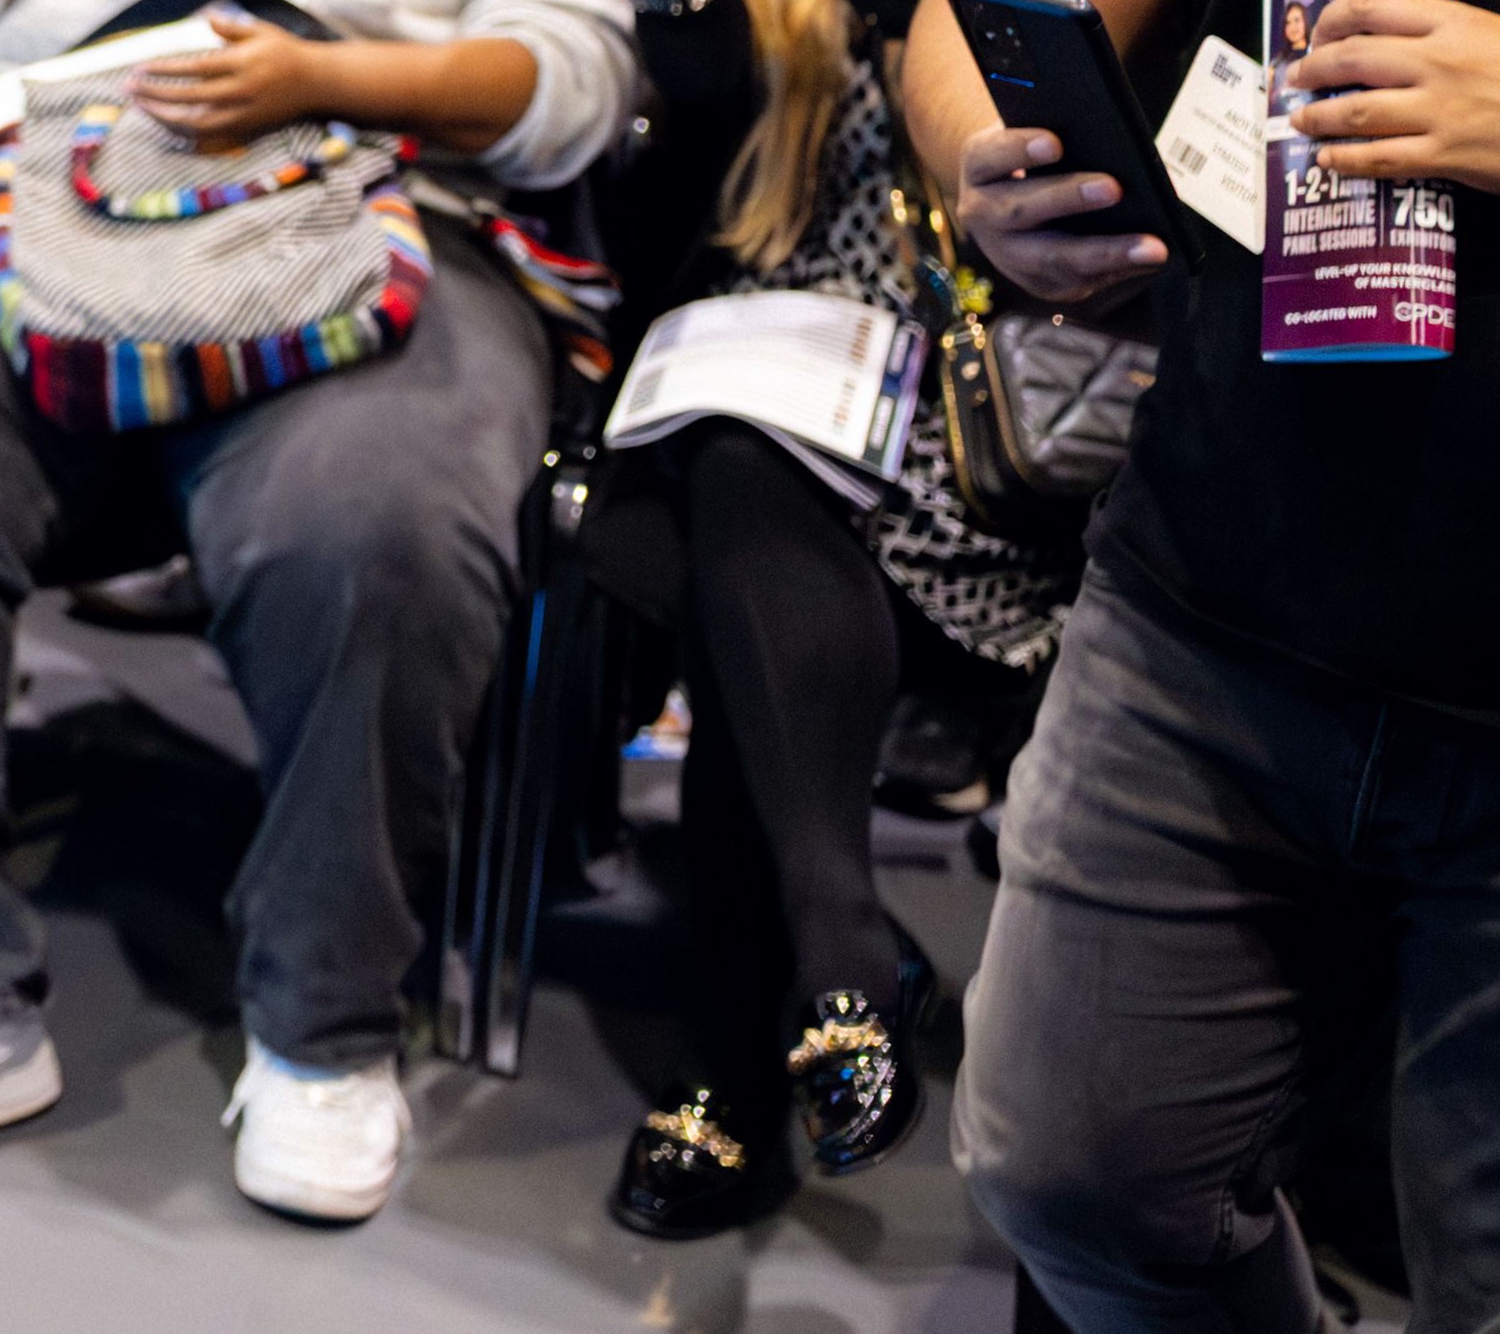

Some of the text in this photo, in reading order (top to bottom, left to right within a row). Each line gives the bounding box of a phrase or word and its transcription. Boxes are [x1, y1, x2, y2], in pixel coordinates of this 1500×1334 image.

[1285, 165, 1340, 207] 1-2-1
[1283, 199, 1376, 235] INTERACTIVE
[1393, 186, 1455, 233] 750
[1282, 227, 1377, 257] PANEL SESSIONS
[1315, 264, 1359, 280] LEVEL-UP
[1360, 263, 1391, 276] YOUR
[1355, 277, 1369, 290] OF
[1285, 306, 1378, 326] CO-LOCATED WITH
